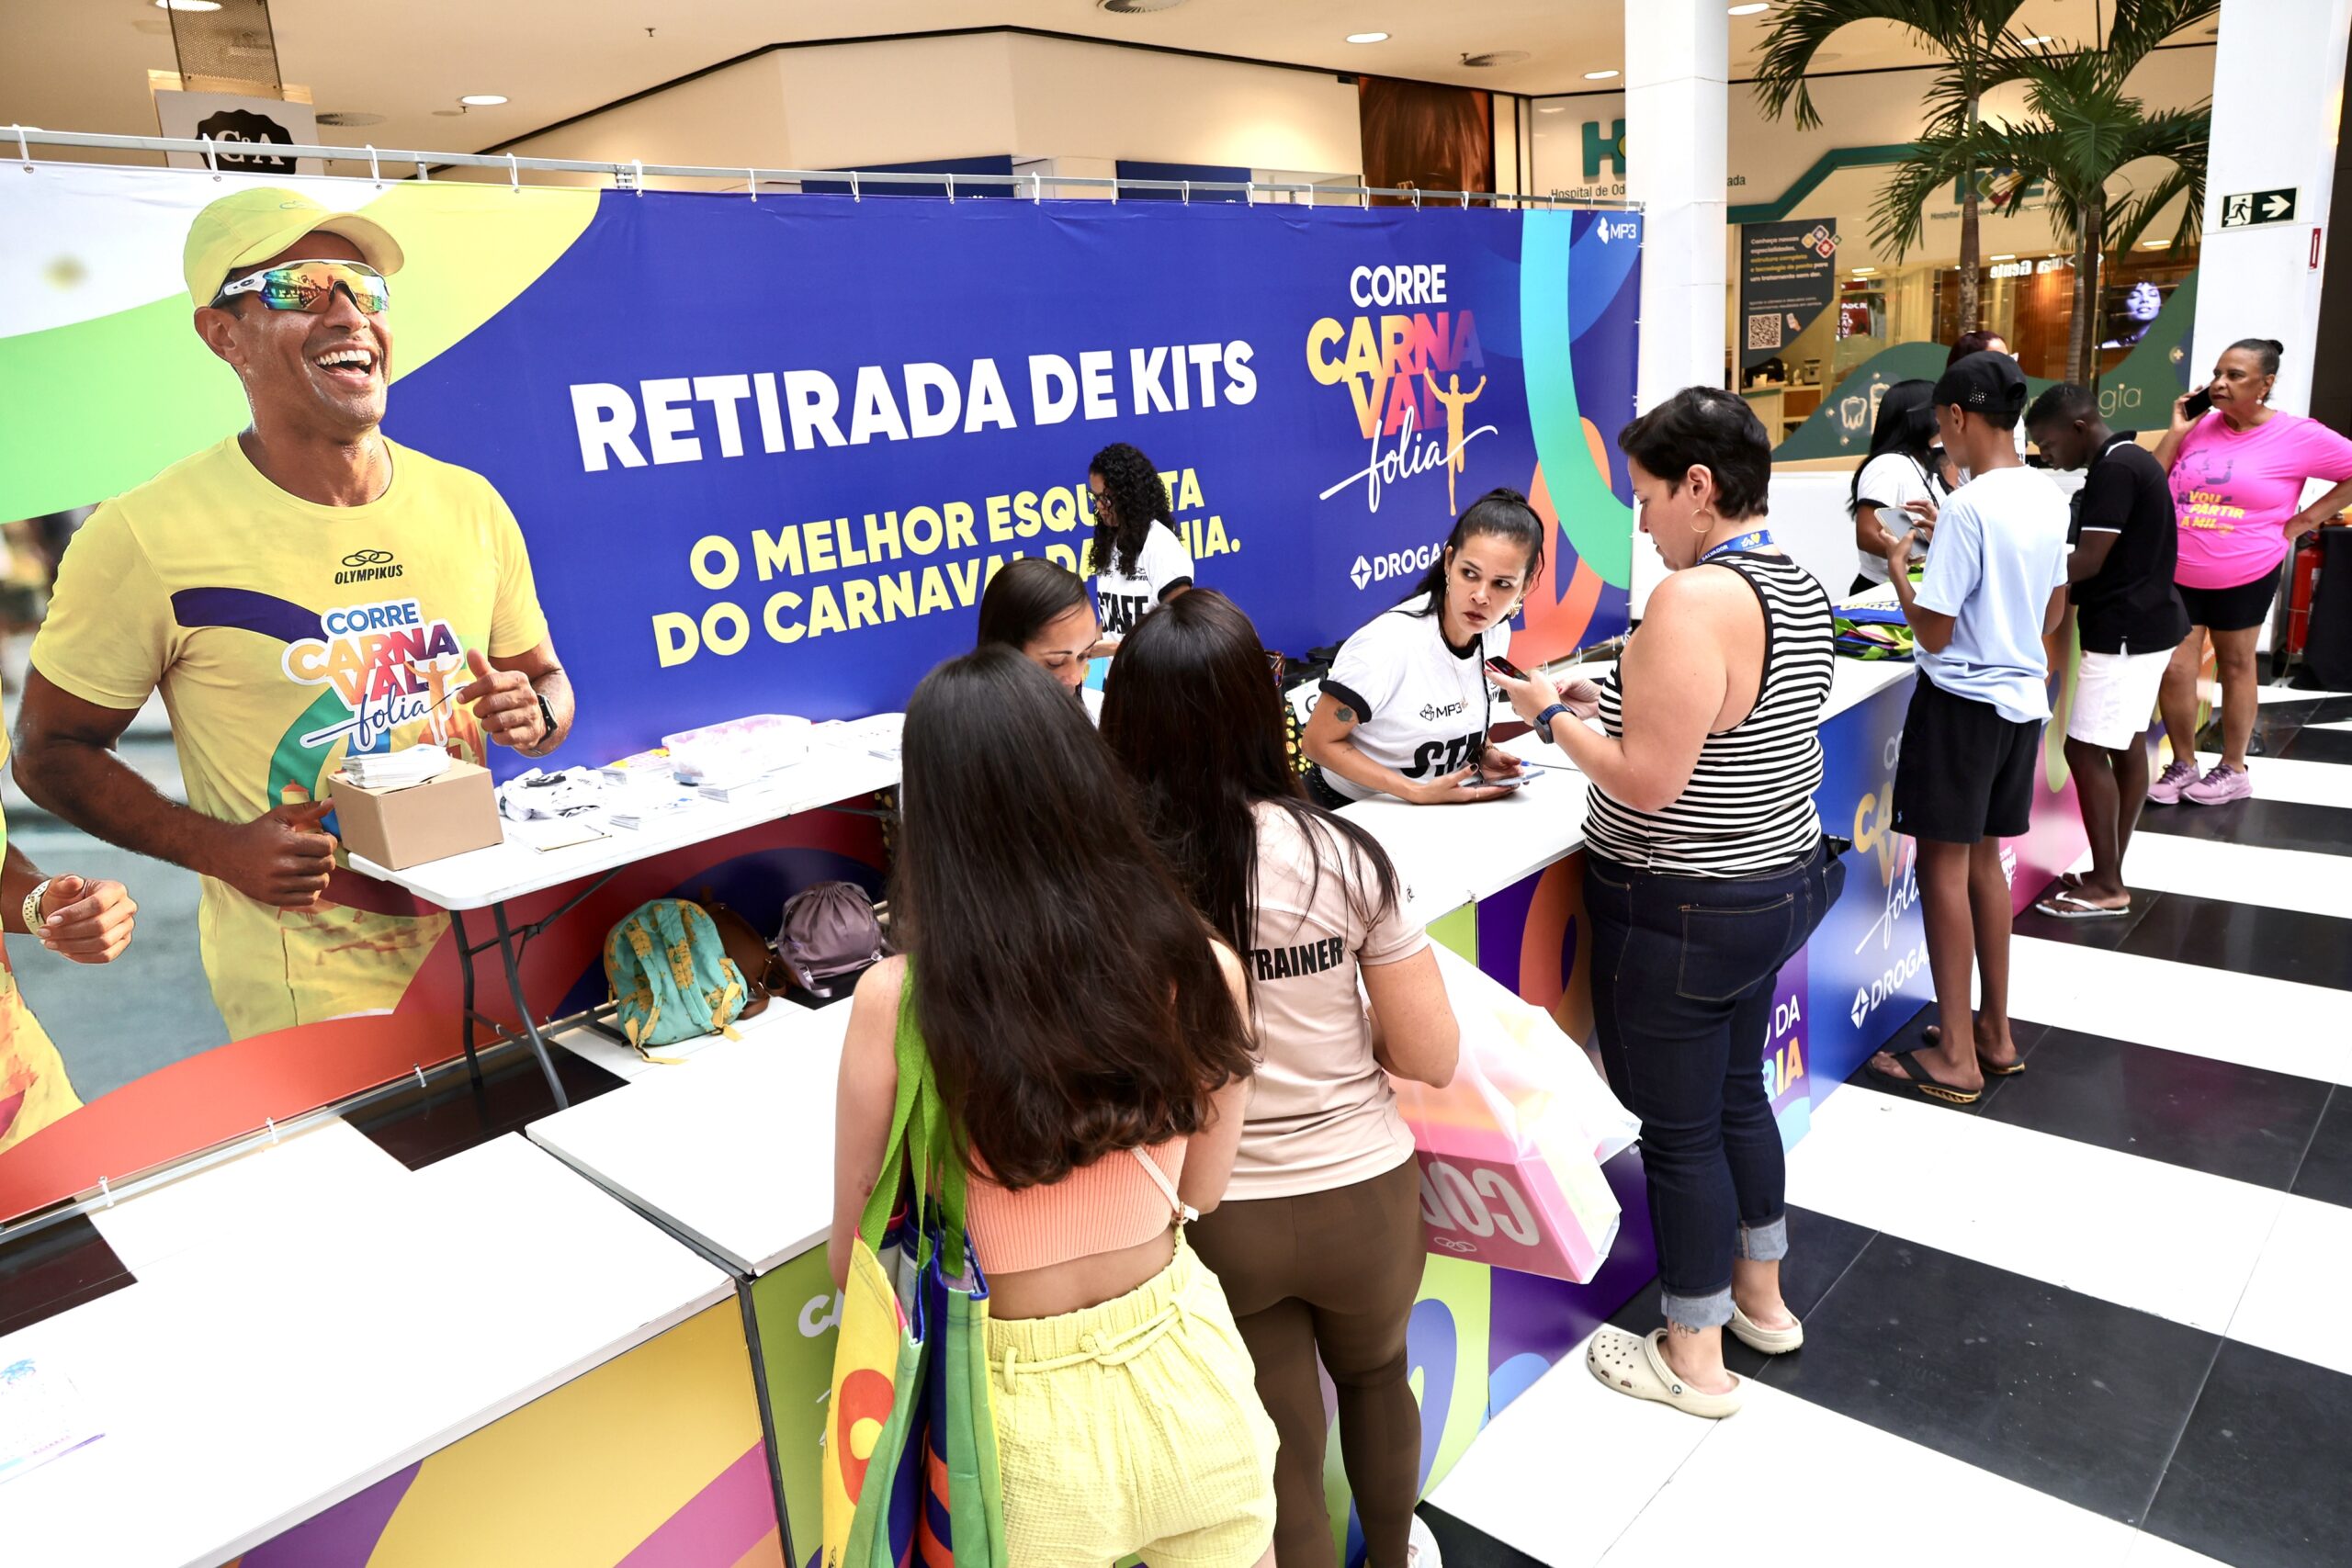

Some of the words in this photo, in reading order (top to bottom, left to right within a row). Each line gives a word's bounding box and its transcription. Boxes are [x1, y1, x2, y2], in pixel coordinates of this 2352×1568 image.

[1551, 186, 1592, 198] Hospital
[1596, 185, 1608, 197] de
[1727, 175, 1747, 186] ada
[1610, 223, 1636, 240] MP3
[1350, 264, 1447, 308] CORRE
[1306, 310, 1486, 386] CARNA
[570, 358, 1018, 472] RETIRADA
[1028, 350, 1118, 425] DE
[1130, 340, 1258, 415] KITS
[1319, 405, 1498, 513] folia
[2189, 491, 2222, 503] VOU
[2190, 503, 2245, 519] PARTIR
[690, 535, 740, 591] O
[752, 502, 978, 581] MELHOR
[986, 468, 1205, 543] ESQUTA
[2180, 516, 2190, 526] A
[334, 564, 403, 585] OLYMPIKUS
[1374, 541, 1448, 581] DROGA
[326, 603, 419, 635] CORRE
[651, 602, 751, 668] DO
[763, 550, 1024, 644] CARNAVA
[288, 624, 459, 681] CARNA
[307, 683, 468, 747] folia
[1436, 702, 1463, 718] MP3
[1855, 843, 1920, 954] foli
[1871, 941, 1929, 1011] DROGA
[1775, 994, 1801, 1038] DA
[1761, 1036, 1804, 1103] RIA
